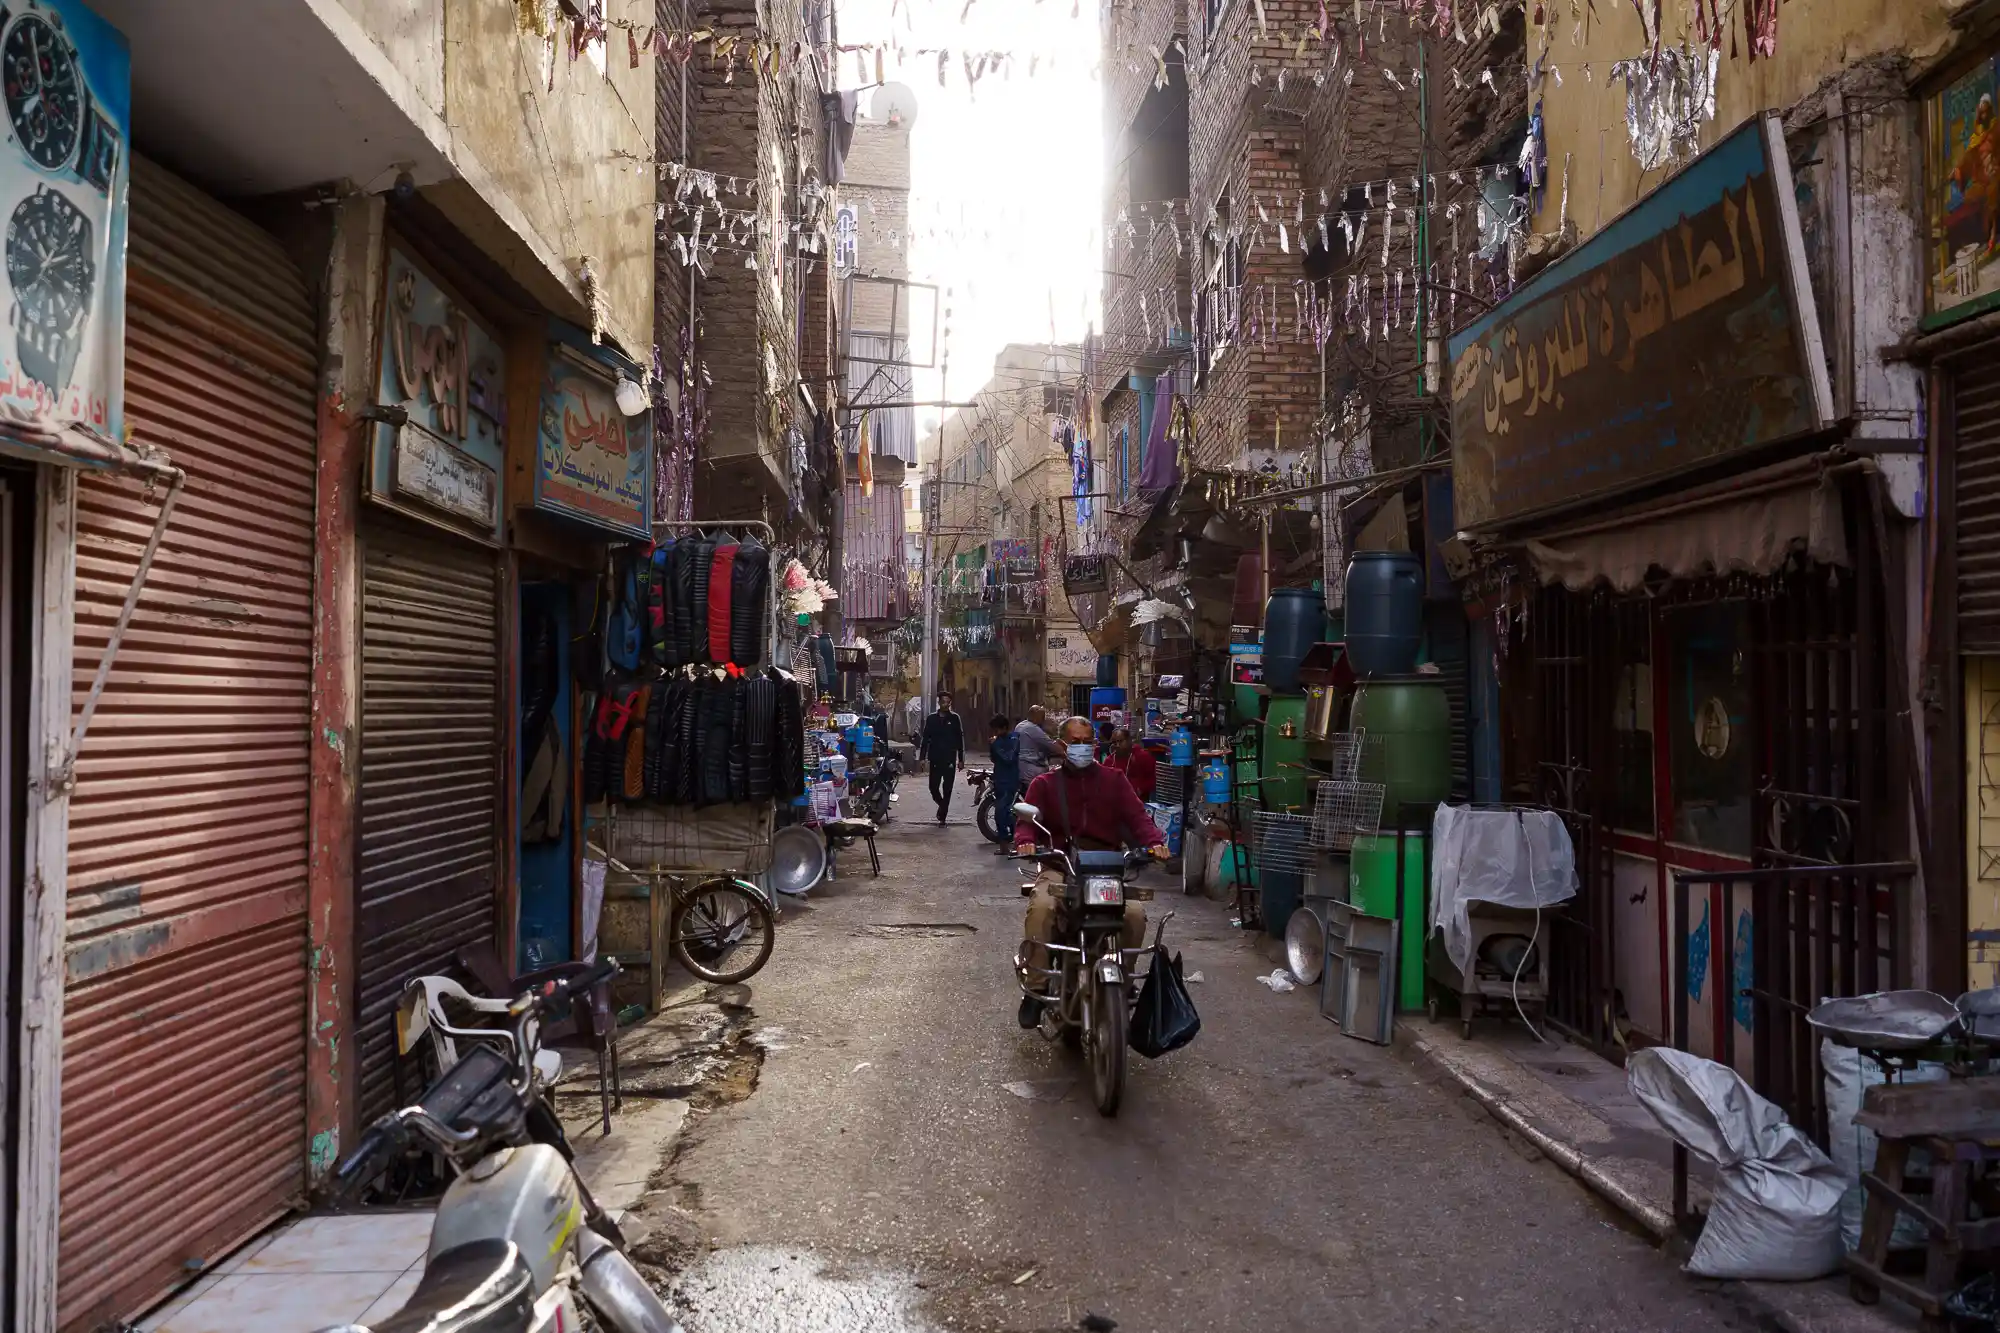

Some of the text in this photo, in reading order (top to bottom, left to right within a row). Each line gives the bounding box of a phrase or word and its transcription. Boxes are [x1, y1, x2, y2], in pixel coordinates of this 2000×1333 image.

[1590, 173, 1766, 373] الطاهرة
[0, 360, 53, 418] رومان
[1484, 286, 1590, 436] للبروتين
[542, 444, 613, 494] الموتسيكلات
